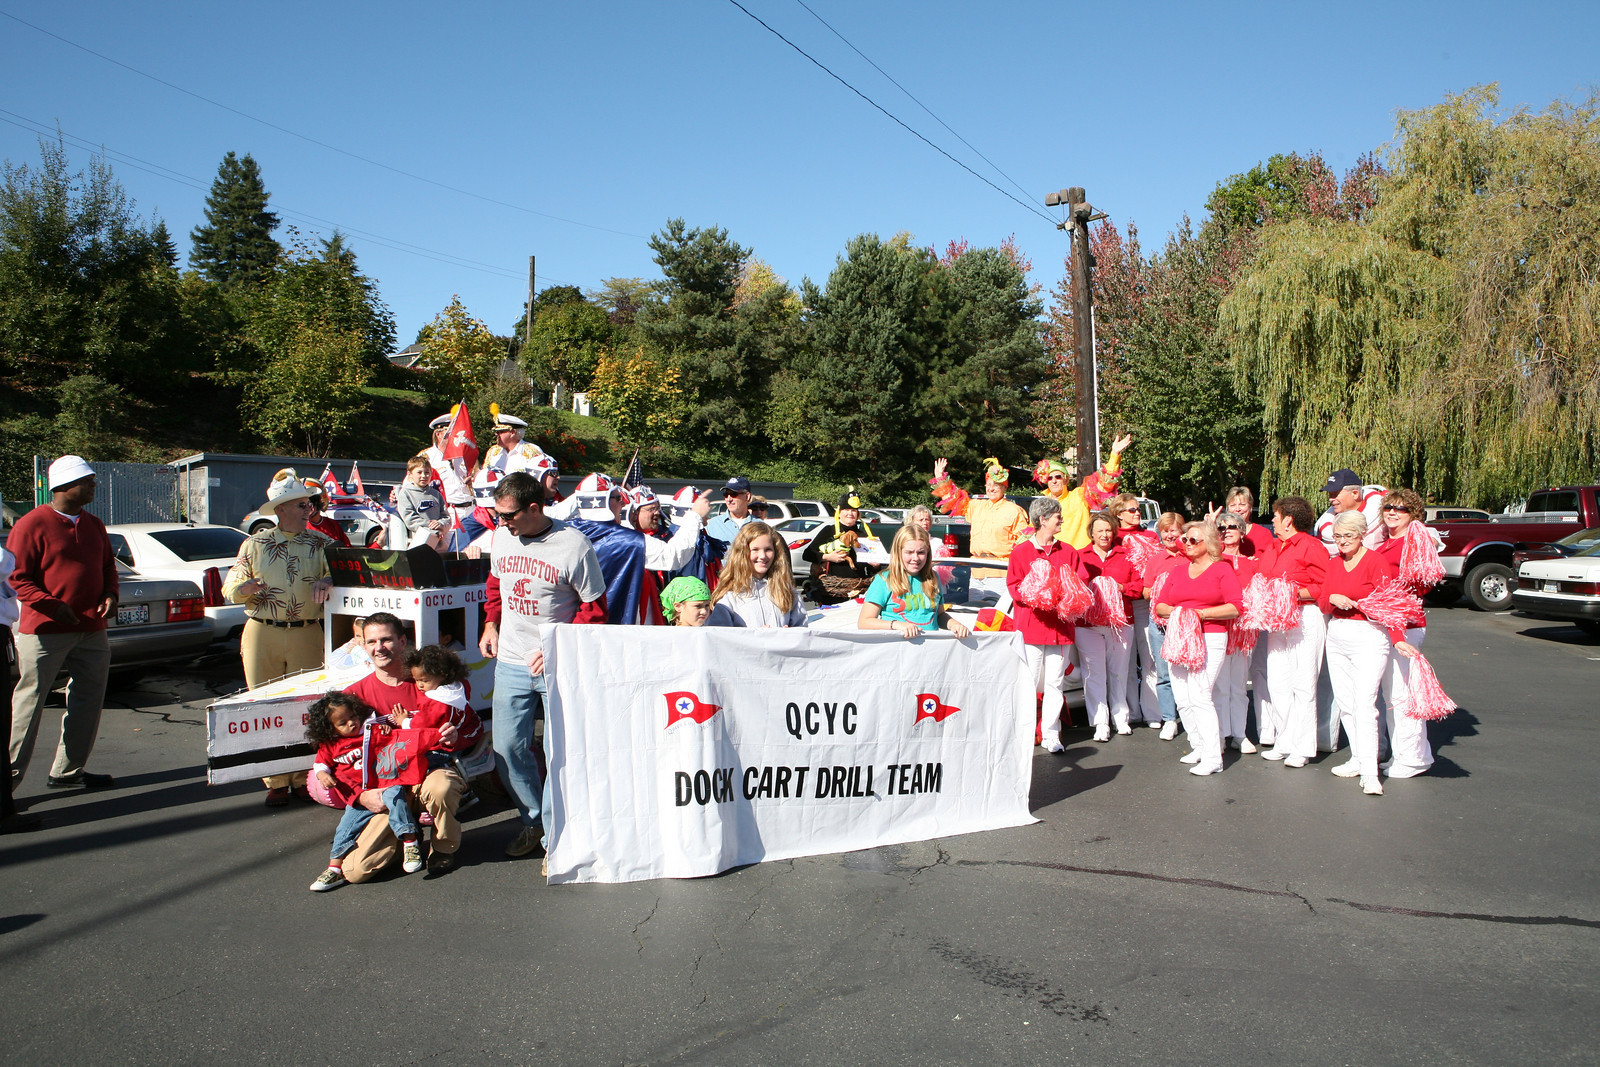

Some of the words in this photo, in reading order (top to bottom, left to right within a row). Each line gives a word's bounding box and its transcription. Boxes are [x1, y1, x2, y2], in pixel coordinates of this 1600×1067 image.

[496, 556, 560, 585] WASHINGTON
[360, 574, 366, 584] A
[372, 575, 414, 588] GALLON
[343, 596, 364, 608] FOR
[374, 597, 402, 609] SALE
[465, 589, 488, 602] CLOS
[508, 596, 540, 616] STATE
[118, 610, 149, 622] 994-SER
[228, 715, 283, 734] GOING
[785, 702, 858, 740] QCYC
[675, 767, 735, 807] DOCK
[742, 766, 809, 801] CART
[815, 765, 875, 799] DRILL
[887, 763, 943, 795] TEAM
